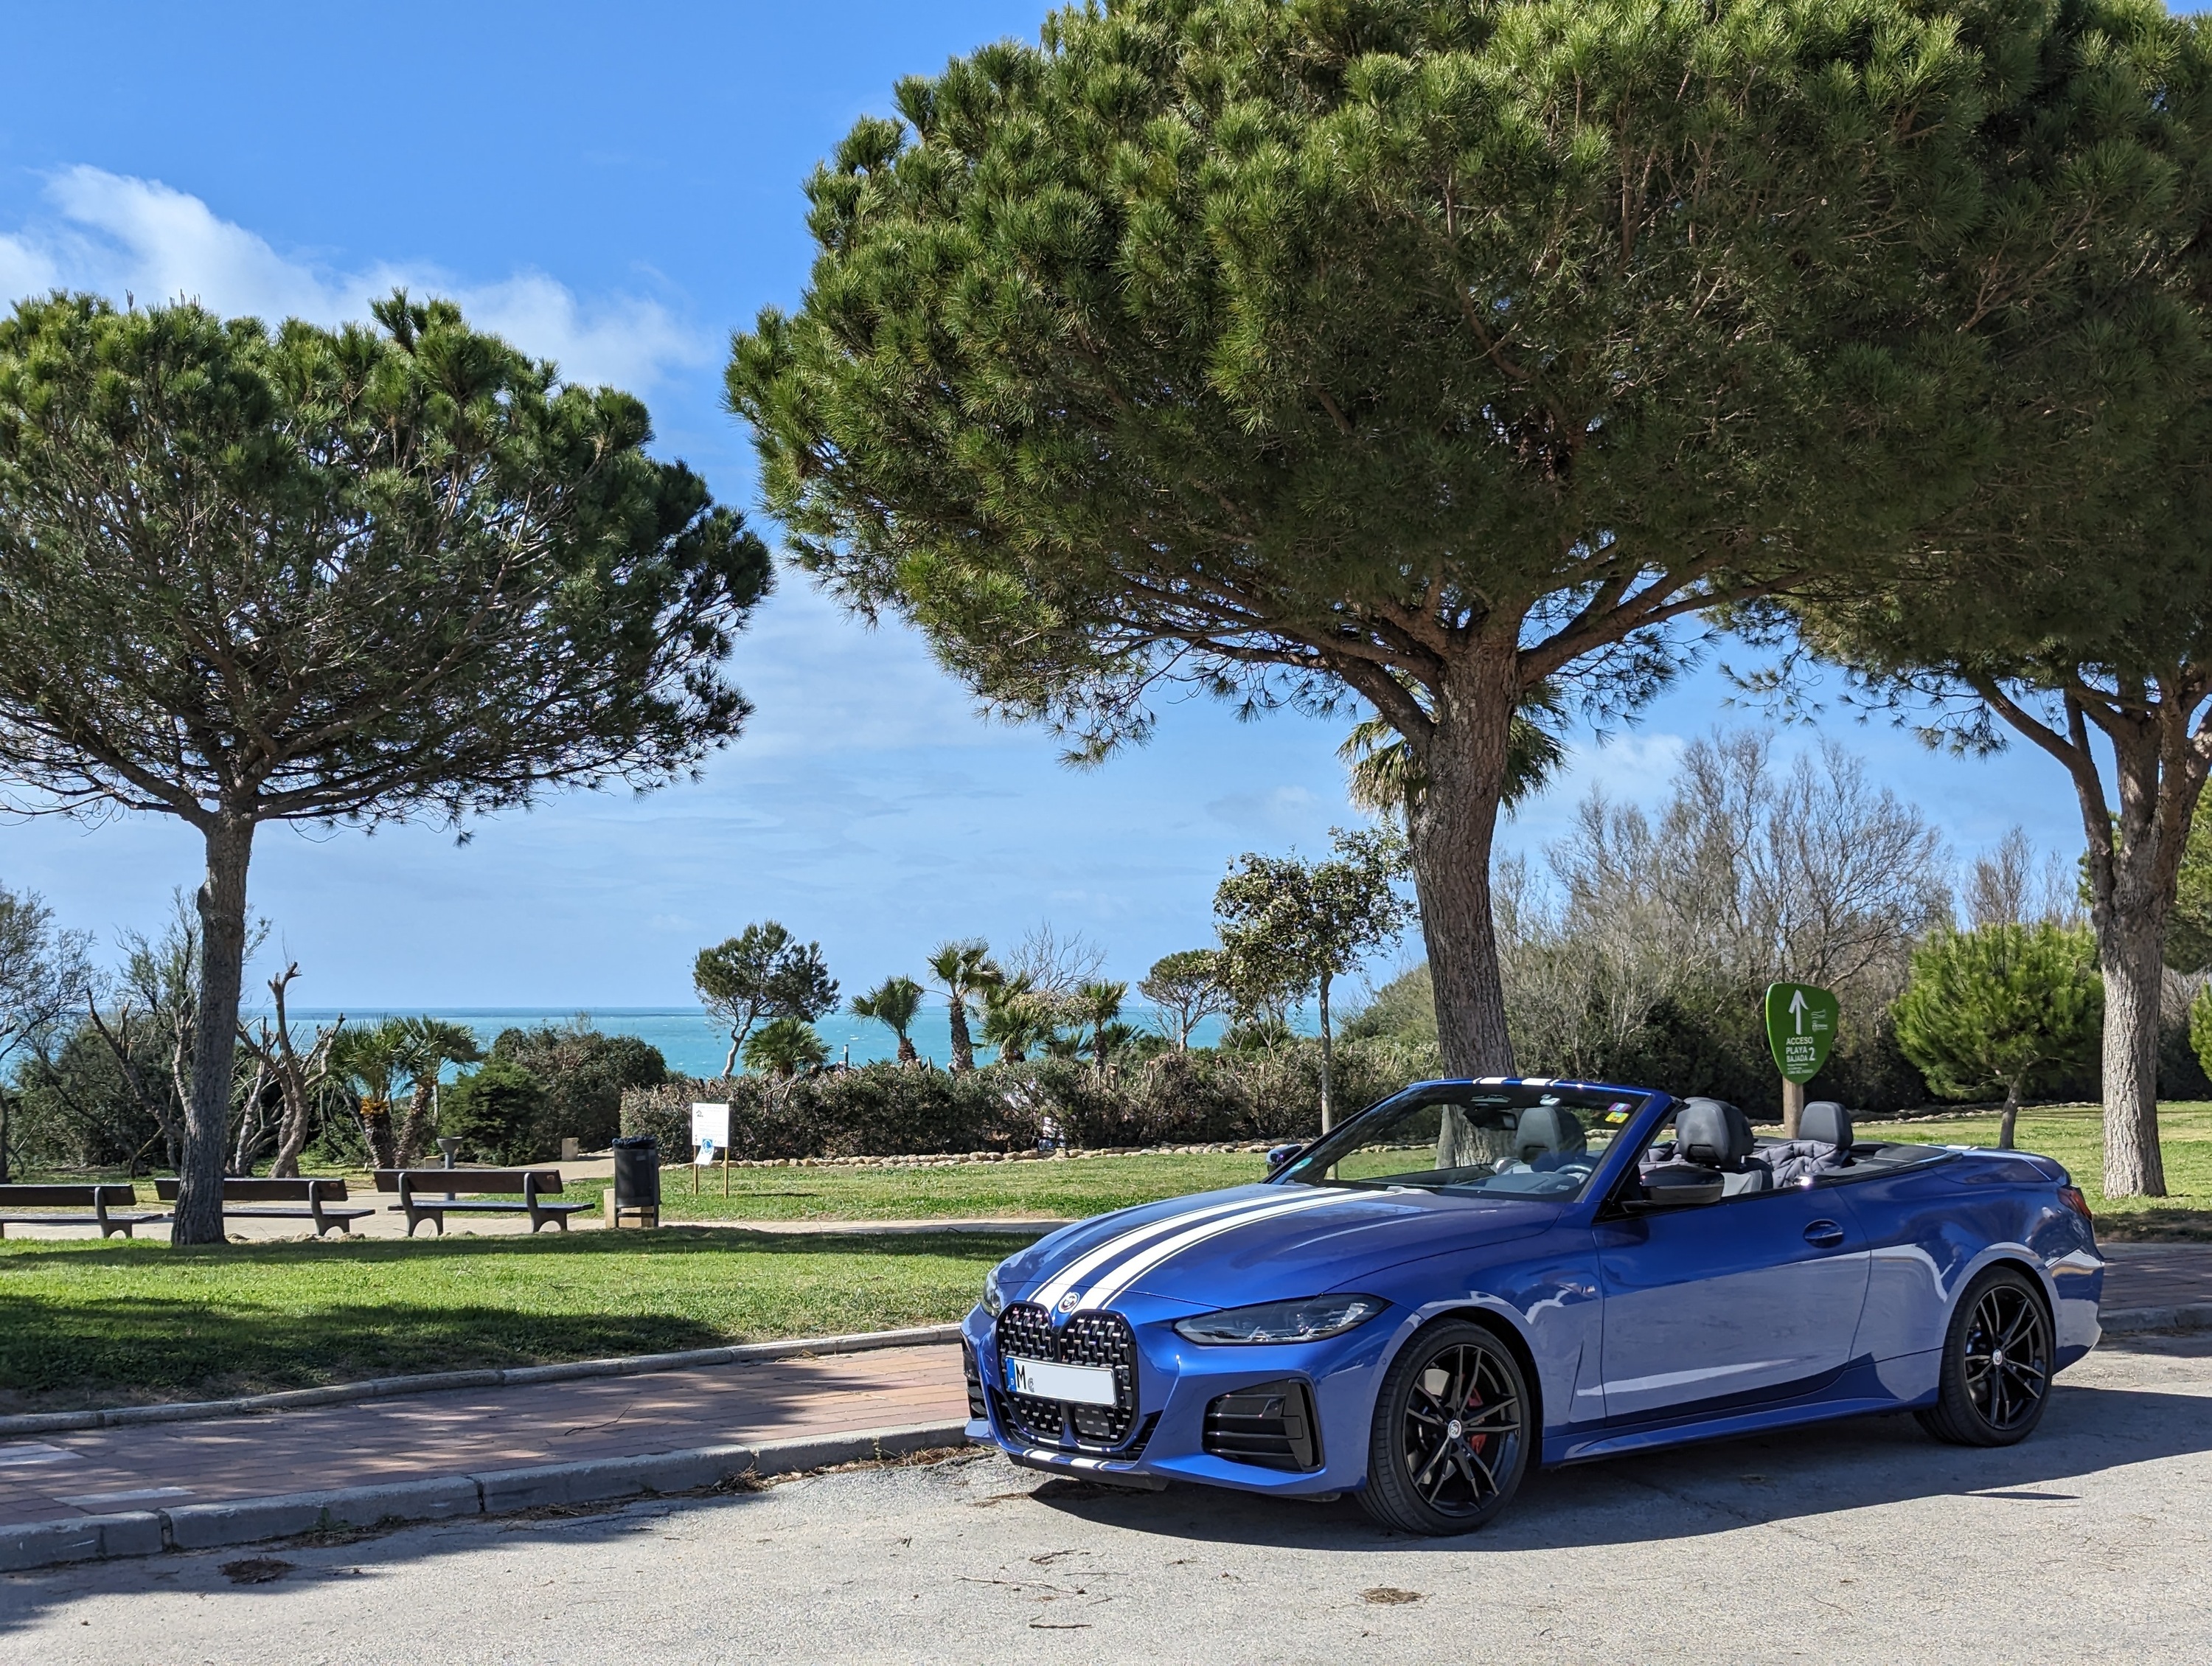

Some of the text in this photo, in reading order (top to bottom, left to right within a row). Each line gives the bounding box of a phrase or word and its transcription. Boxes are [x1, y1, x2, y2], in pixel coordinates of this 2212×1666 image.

[1786, 1036, 1813, 1045] ACCESO
[1786, 1046, 1808, 1055] PLAYA
[1786, 1047, 1815, 1063] BAJADA 2
[1015, 1364, 1027, 1390] M
